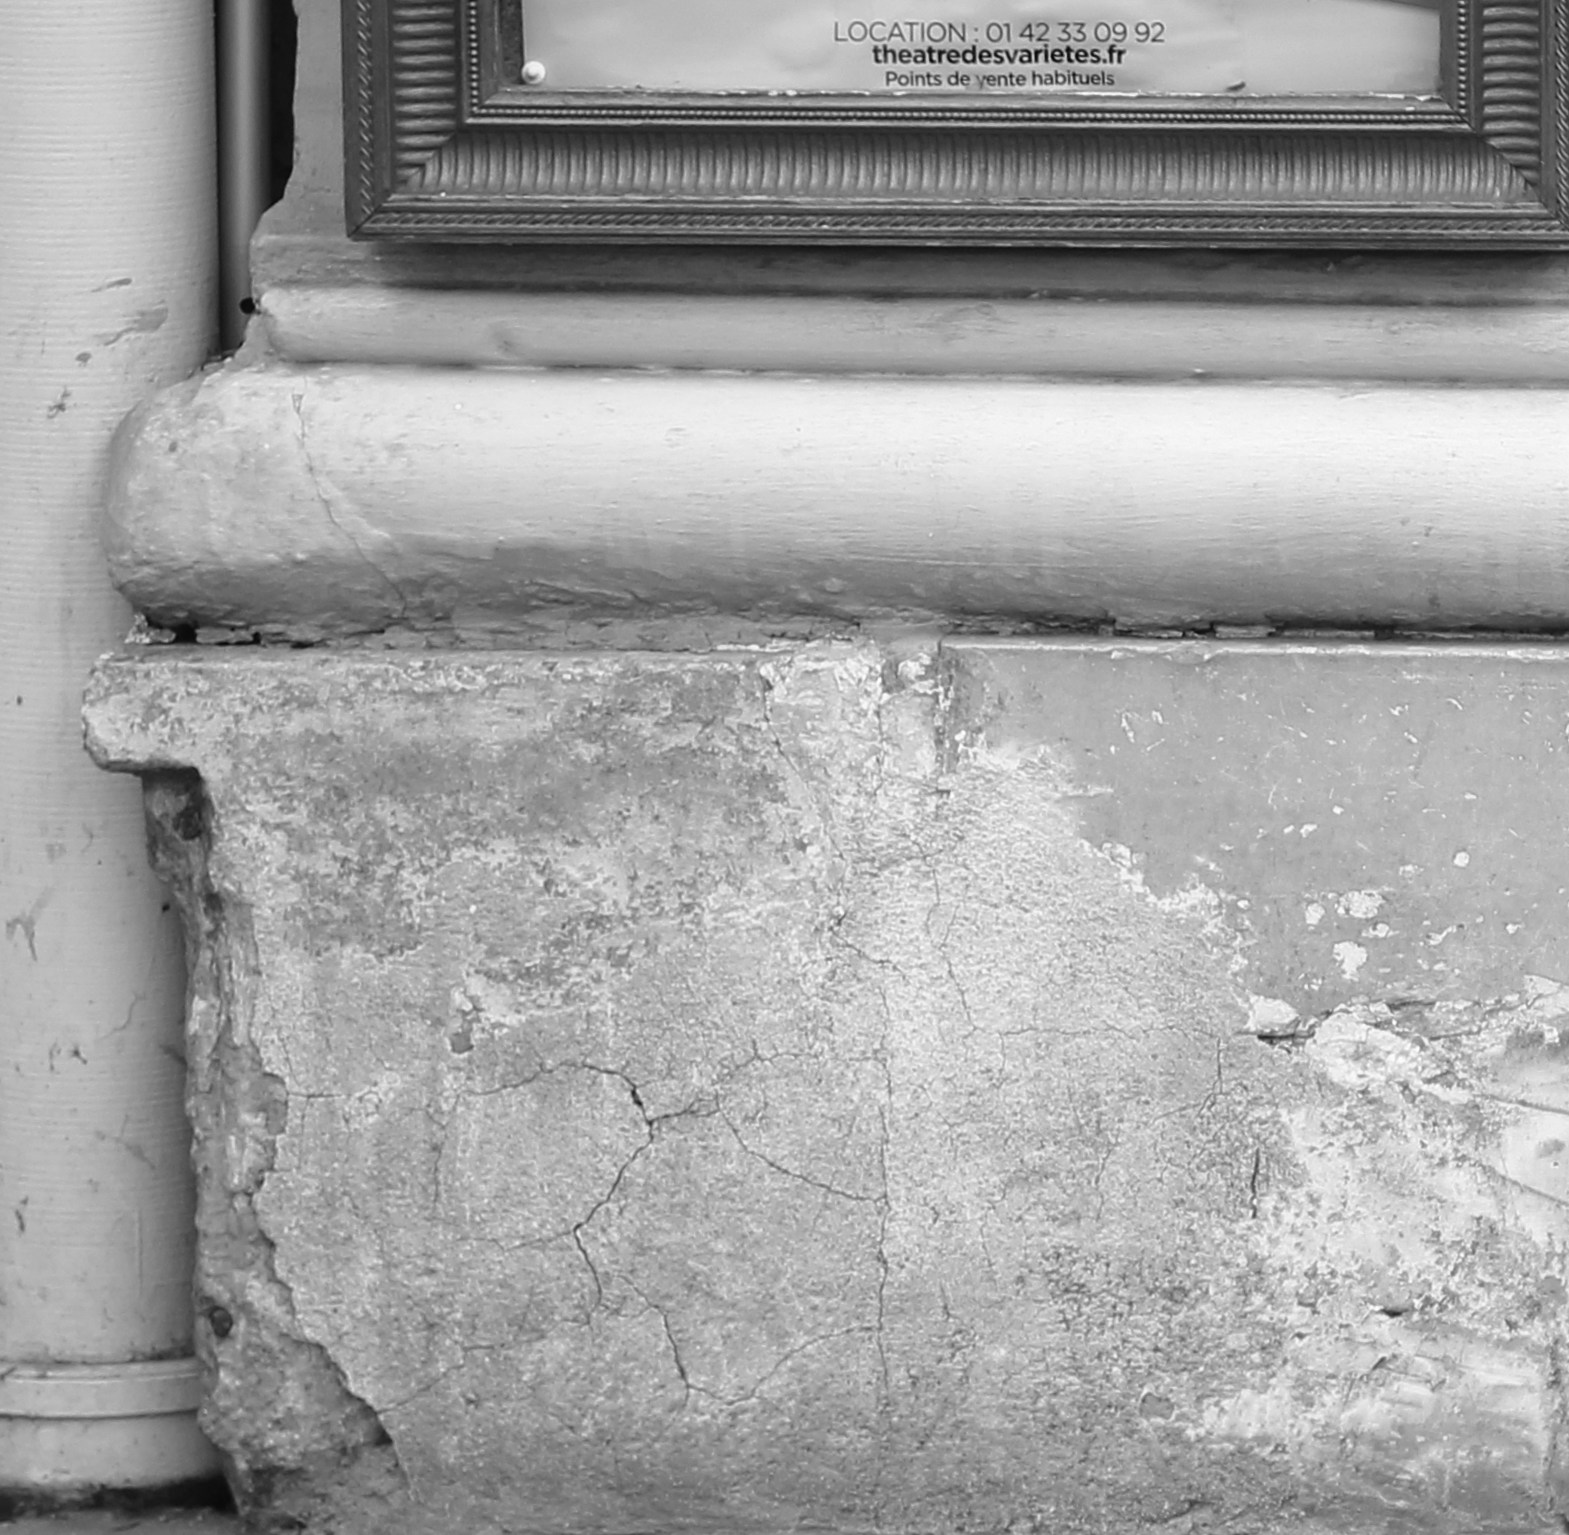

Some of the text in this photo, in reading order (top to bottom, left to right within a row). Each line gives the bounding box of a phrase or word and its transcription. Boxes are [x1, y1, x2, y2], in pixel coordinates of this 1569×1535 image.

[833, 21, 967, 43] LOCATION
[985, 22, 1011, 43] 01
[1018, 22, 1050, 43] 42
[1056, 22, 1087, 43] 33
[1093, 22, 1128, 44] 09
[1133, 22, 1166, 44] 92
[872, 43, 1127, 65] theatredesvarietes.fr
[885, 70, 1115, 91] Points de vente habituels
